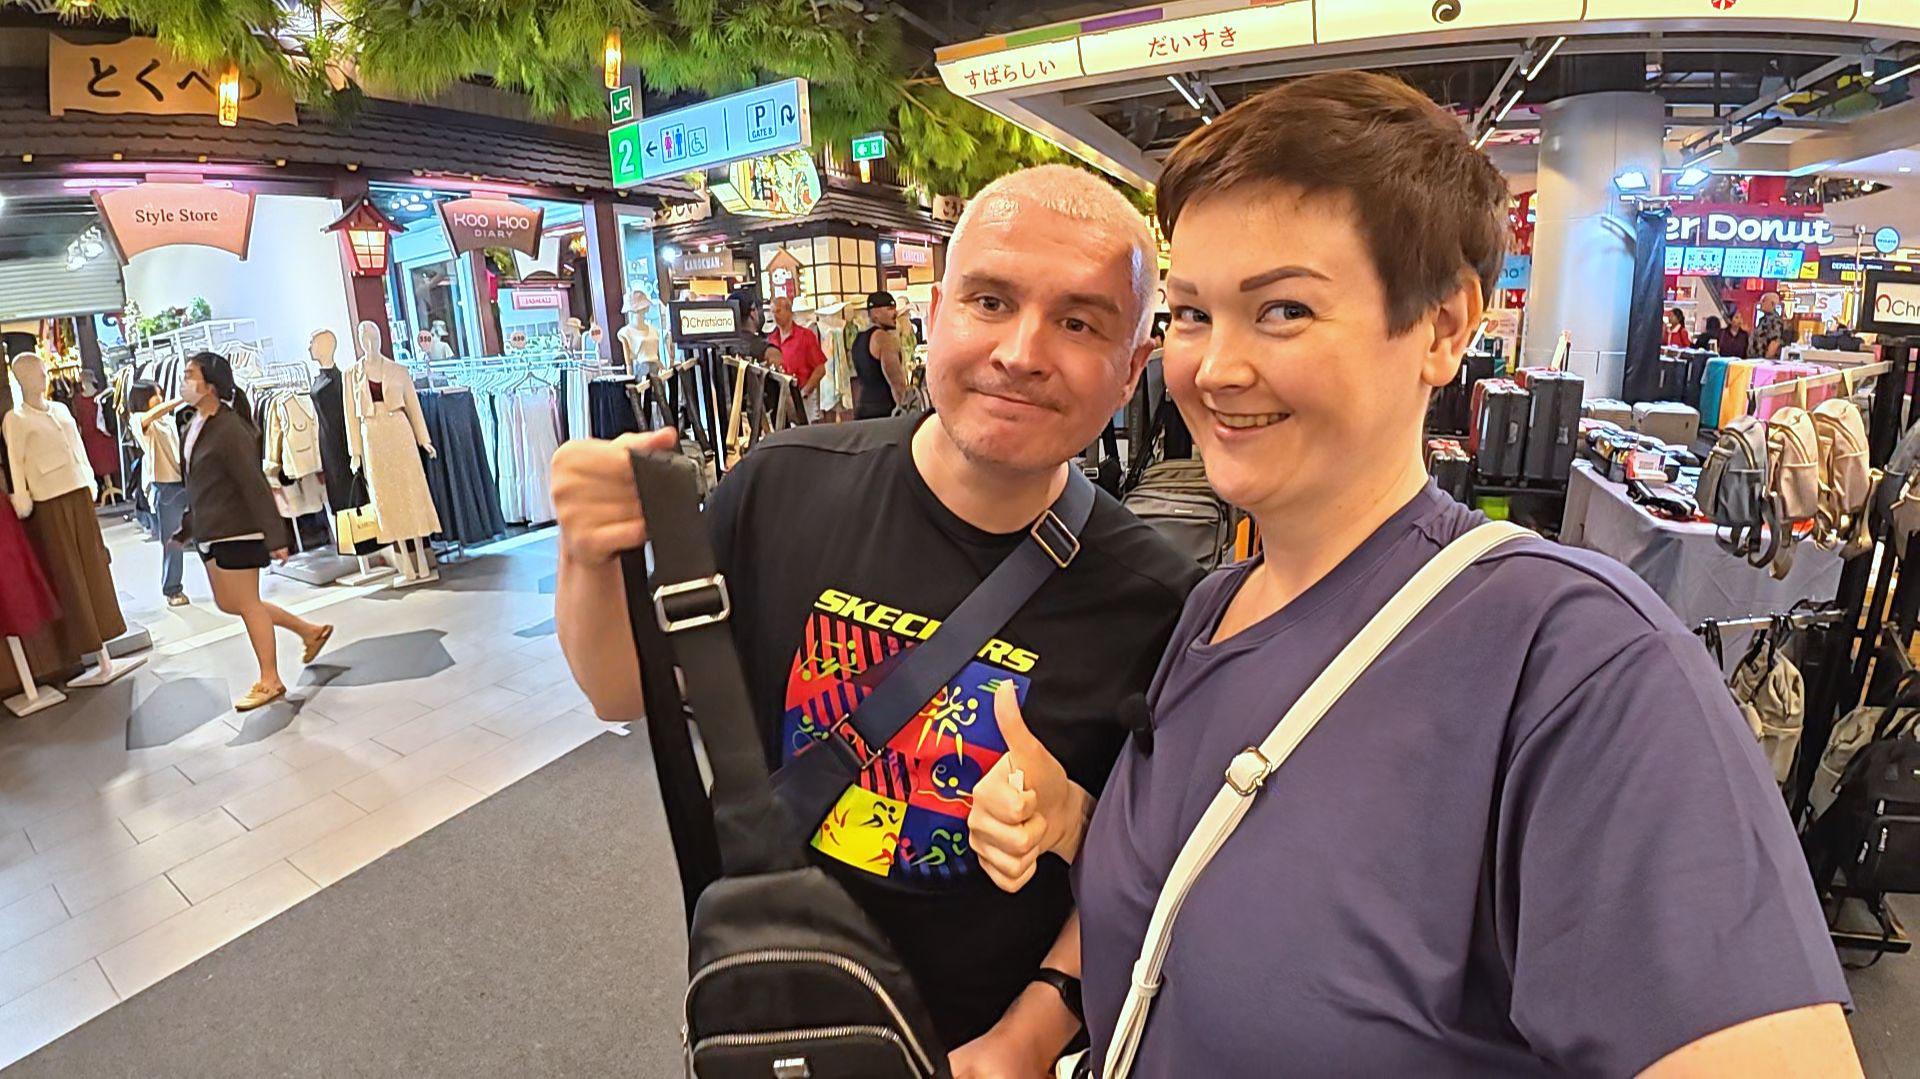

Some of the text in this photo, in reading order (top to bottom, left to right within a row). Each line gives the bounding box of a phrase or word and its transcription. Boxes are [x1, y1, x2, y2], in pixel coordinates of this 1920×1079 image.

[1148, 26, 1237, 58] だいすき
[964, 60, 1056, 89] すばらしい
[614, 96, 630, 114] JR
[755, 105, 766, 127] P
[752, 128, 767, 138] GATE
[618, 139, 635, 175] 2
[135, 208, 218, 226] Style Store
[453, 213, 530, 230] KOO HOO
[474, 229, 513, 239] DIARY
[1707, 213, 1834, 245] Donut
[813, 588, 1040, 673] SKECRS
